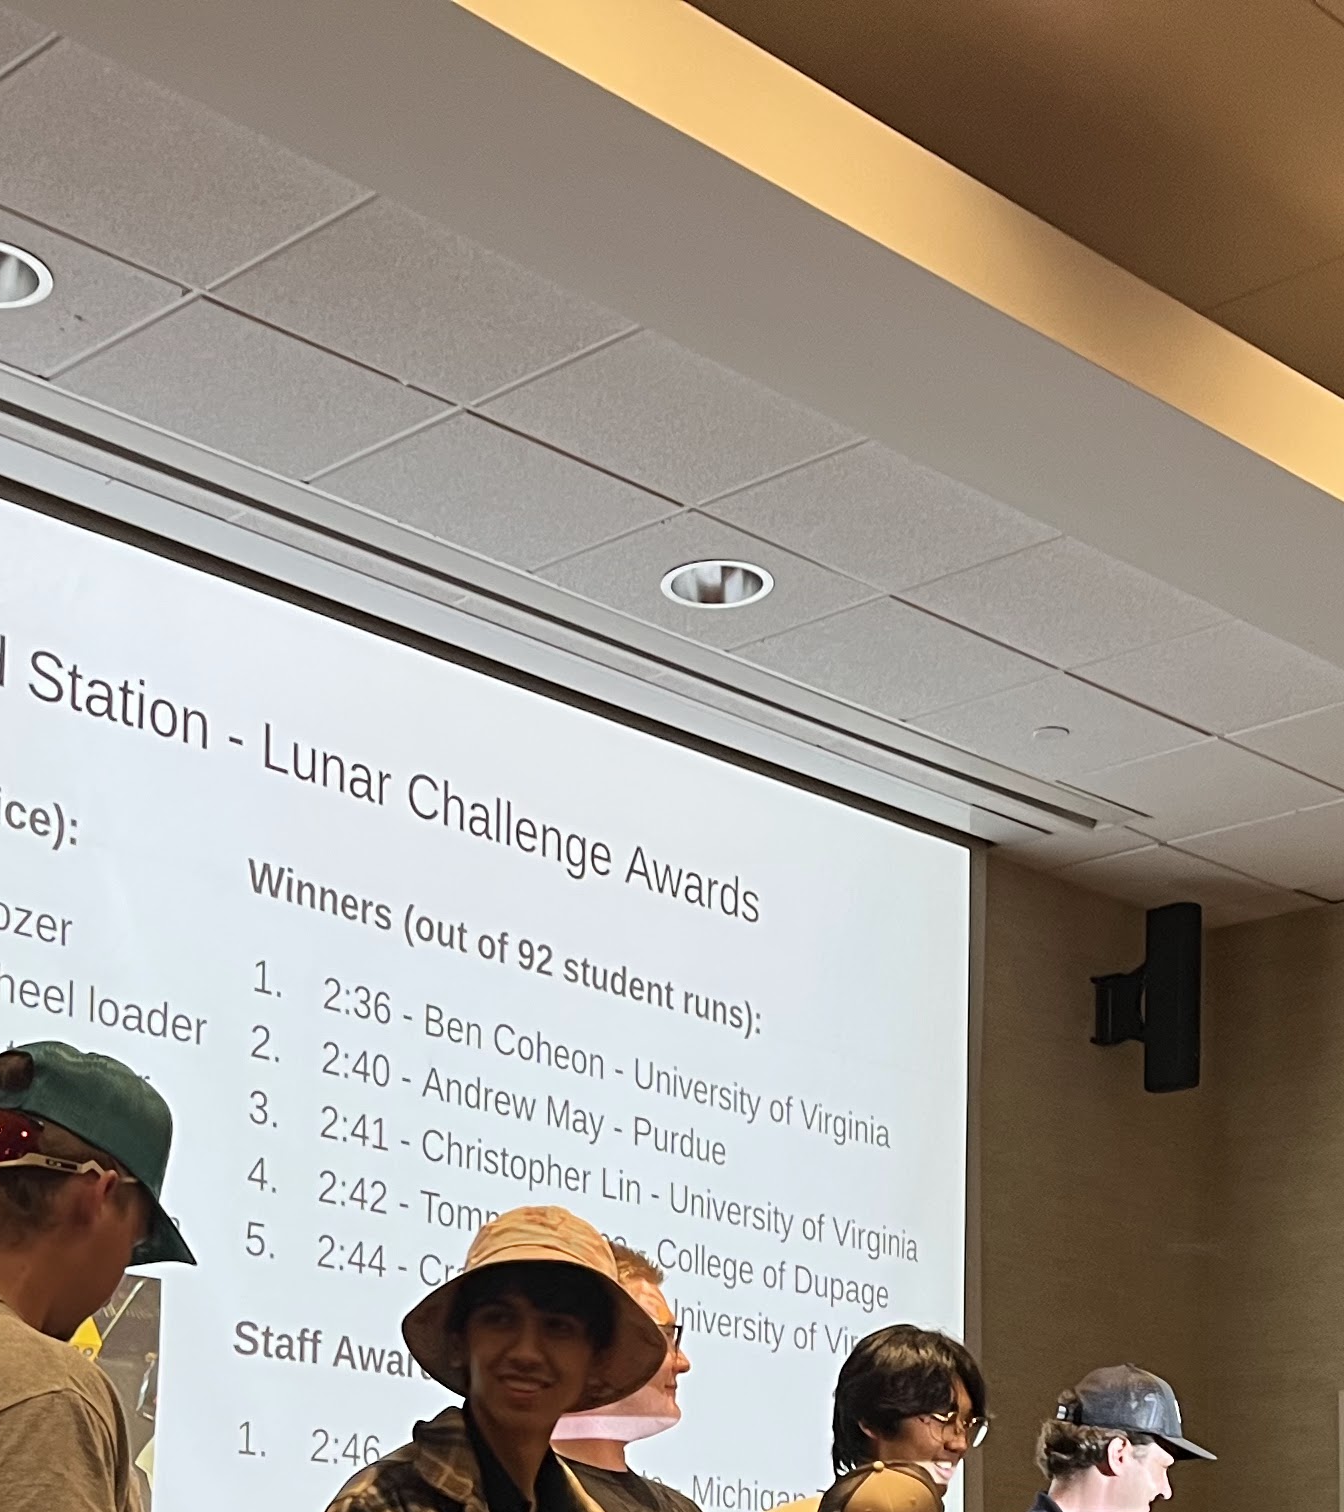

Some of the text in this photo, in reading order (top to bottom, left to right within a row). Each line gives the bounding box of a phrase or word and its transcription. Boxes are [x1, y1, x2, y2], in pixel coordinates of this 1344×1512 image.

[28, 650, 208, 750] Station
[228, 735, 243, 746] -
[264, 722, 391, 806] Lunar
[408, 773, 612, 880] Challenge
[624, 845, 760, 923] Awards
[89, 985, 208, 1045] loader
[248, 857, 761, 1040] Winners (out of 92 student runs):
[250, 1025, 280, 1063] 2.
[322, 1041, 391, 1088] 2:40
[421, 1067, 537, 1122] Andrew
[546, 1095, 605, 1145] May
[633, 1116, 727, 1166] Purdue
[253, 960, 282, 998] 1.
[323, 977, 391, 1025] 2:36
[425, 1003, 482, 1050] Ben
[493, 1023, 604, 1080] Coheon
[634, 1057, 761, 1125] University
[769, 1095, 793, 1125] of
[800, 1098, 891, 1149] Virginia
[247, 1157, 277, 1193] 4.
[318, 1169, 388, 1215] 2:42
[656, 1238, 754, 1290] College
[763, 1260, 786, 1291] of
[794, 1264, 889, 1314] Dupage
[249, 1090, 278, 1128] 3.
[320, 1105, 389, 1152] 2:41
[421, 1128, 591, 1194] Christopher
[601, 1166, 641, 1205] Lin
[669, 1181, 794, 1243] University
[802, 1213, 826, 1243] of
[832, 1216, 919, 1263] Virginia
[233, 1320, 323, 1364] Staff
[245, 1221, 274, 1259] 5.
[317, 1234, 387, 1278] 2:44
[793, 1320, 817, 1352] of
[238, 1420, 266, 1457] 1.
[310, 1428, 381, 1467] 2:46
